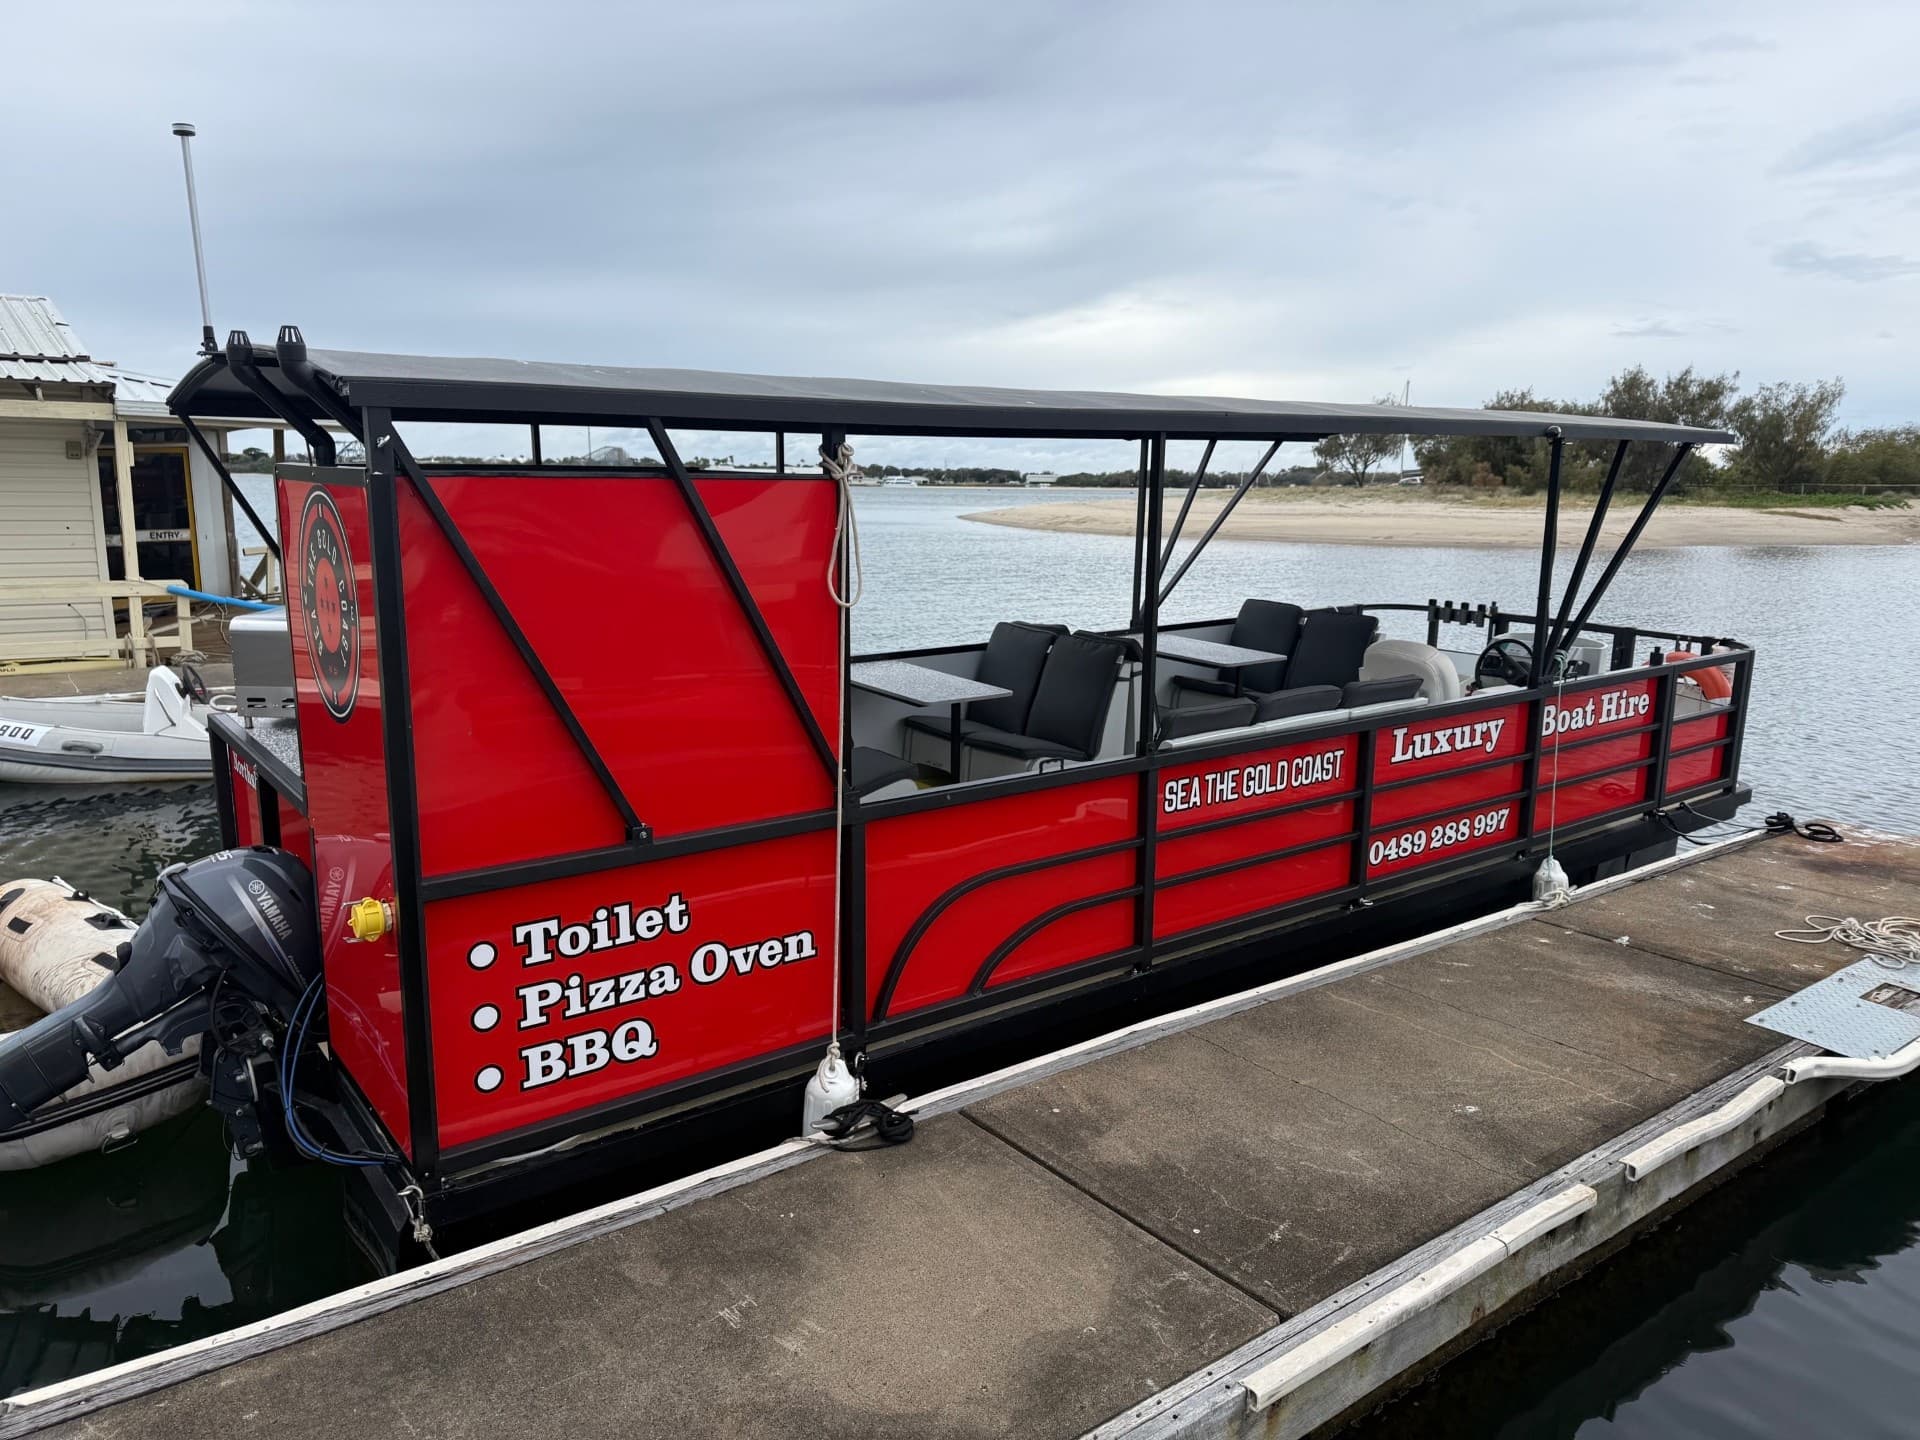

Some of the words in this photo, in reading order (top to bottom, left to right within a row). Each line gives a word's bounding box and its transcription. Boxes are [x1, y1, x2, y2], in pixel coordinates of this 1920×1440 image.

[149, 531, 180, 540] ENTRY
[316, 528, 337, 566] GOLD
[338, 579, 350, 668] COAST
[1390, 718, 1505, 763] Luxury
[1541, 697, 1596, 738] Boat
[1598, 689, 1650, 725] Hire
[1163, 778, 1201, 814] SEA
[1204, 769, 1240, 804] THE
[1241, 760, 1288, 797] GOLD
[1290, 750, 1345, 787] COAST
[1368, 829, 1427, 865] 0489
[1429, 817, 1471, 851] 288
[1472, 807, 1510, 837] 997
[256, 890, 293, 941] YAMAHA
[513, 893, 690, 967] Toilet
[517, 962, 681, 1030] Pizza
[689, 930, 817, 985] Oven
[519, 1018, 658, 1091] BBQ
